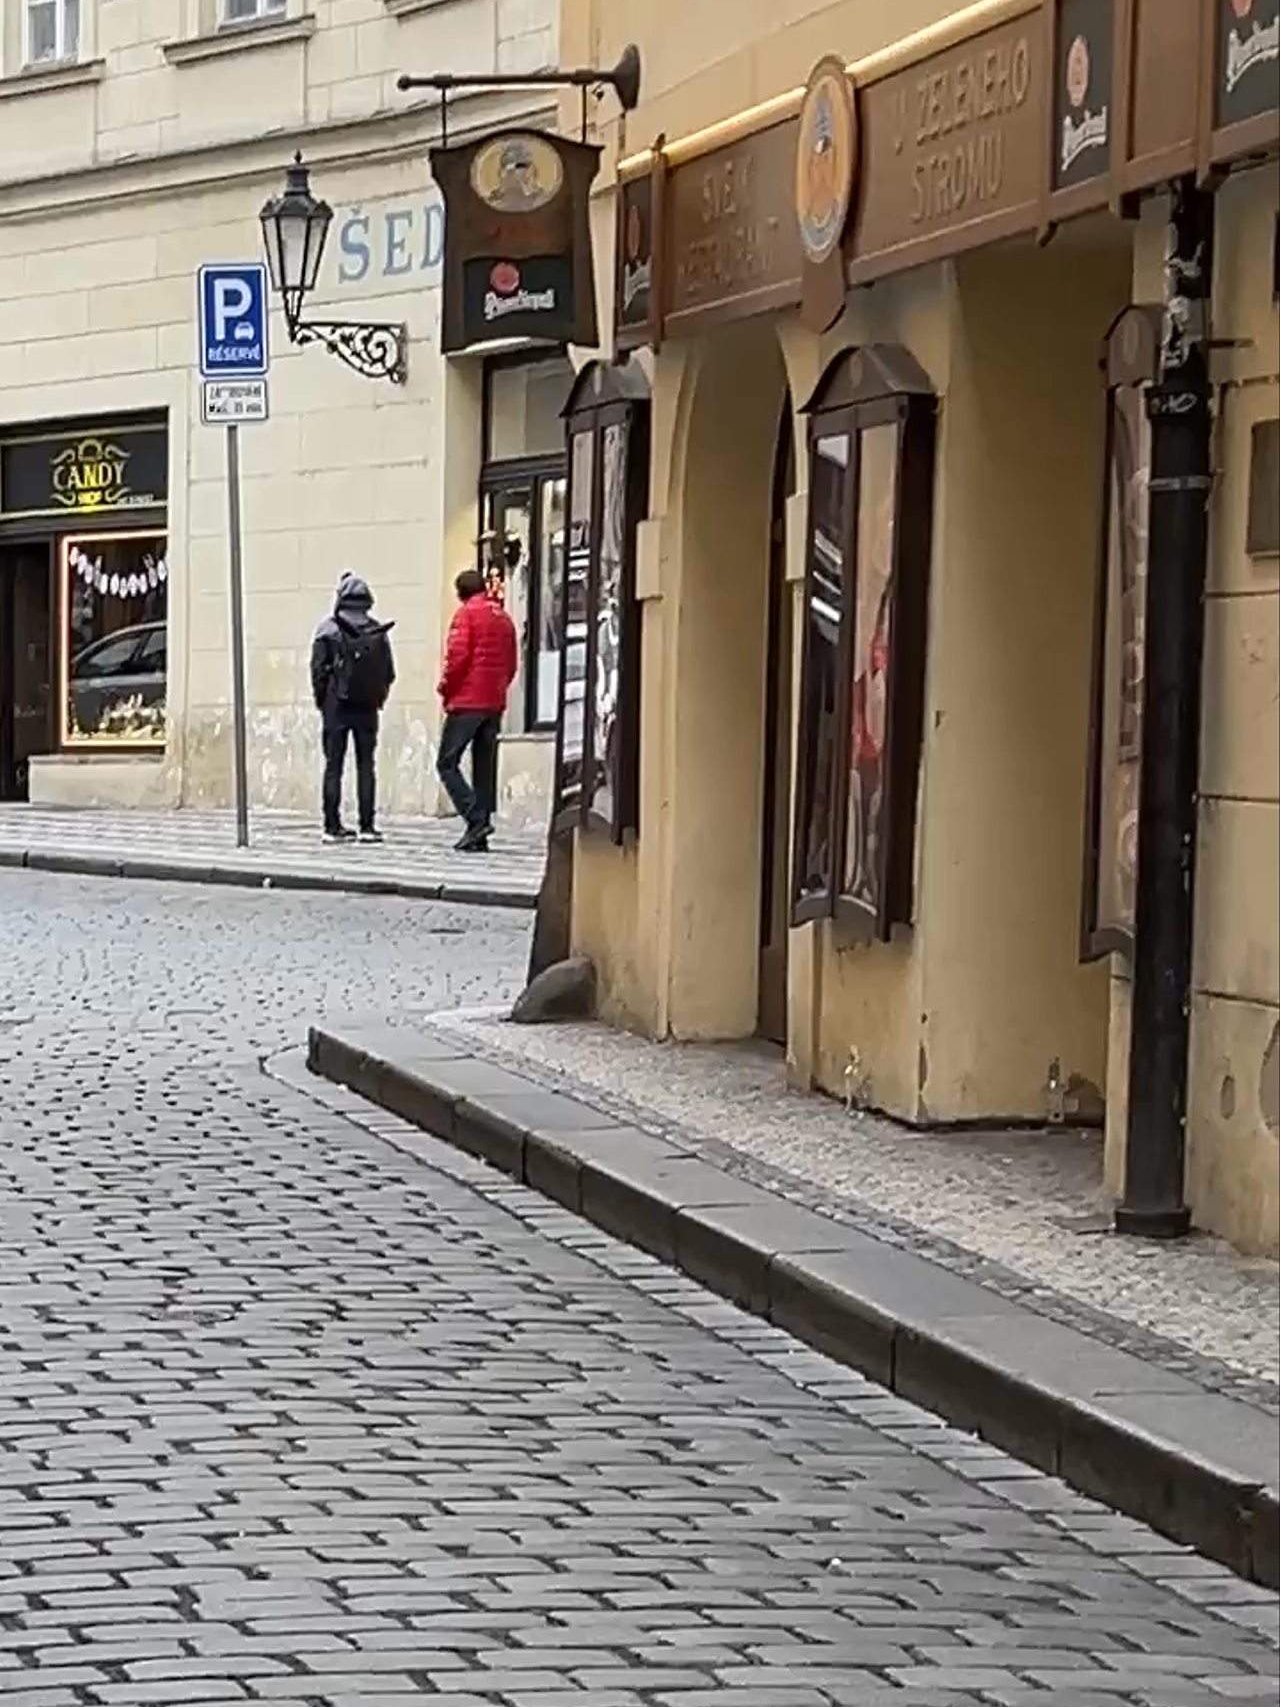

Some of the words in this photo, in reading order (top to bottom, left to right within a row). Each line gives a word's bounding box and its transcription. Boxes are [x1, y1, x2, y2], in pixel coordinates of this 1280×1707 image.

[910, 130, 1003, 224] STROMU
[213, 278, 253, 341] P
[53, 461, 127, 490] CANDY
